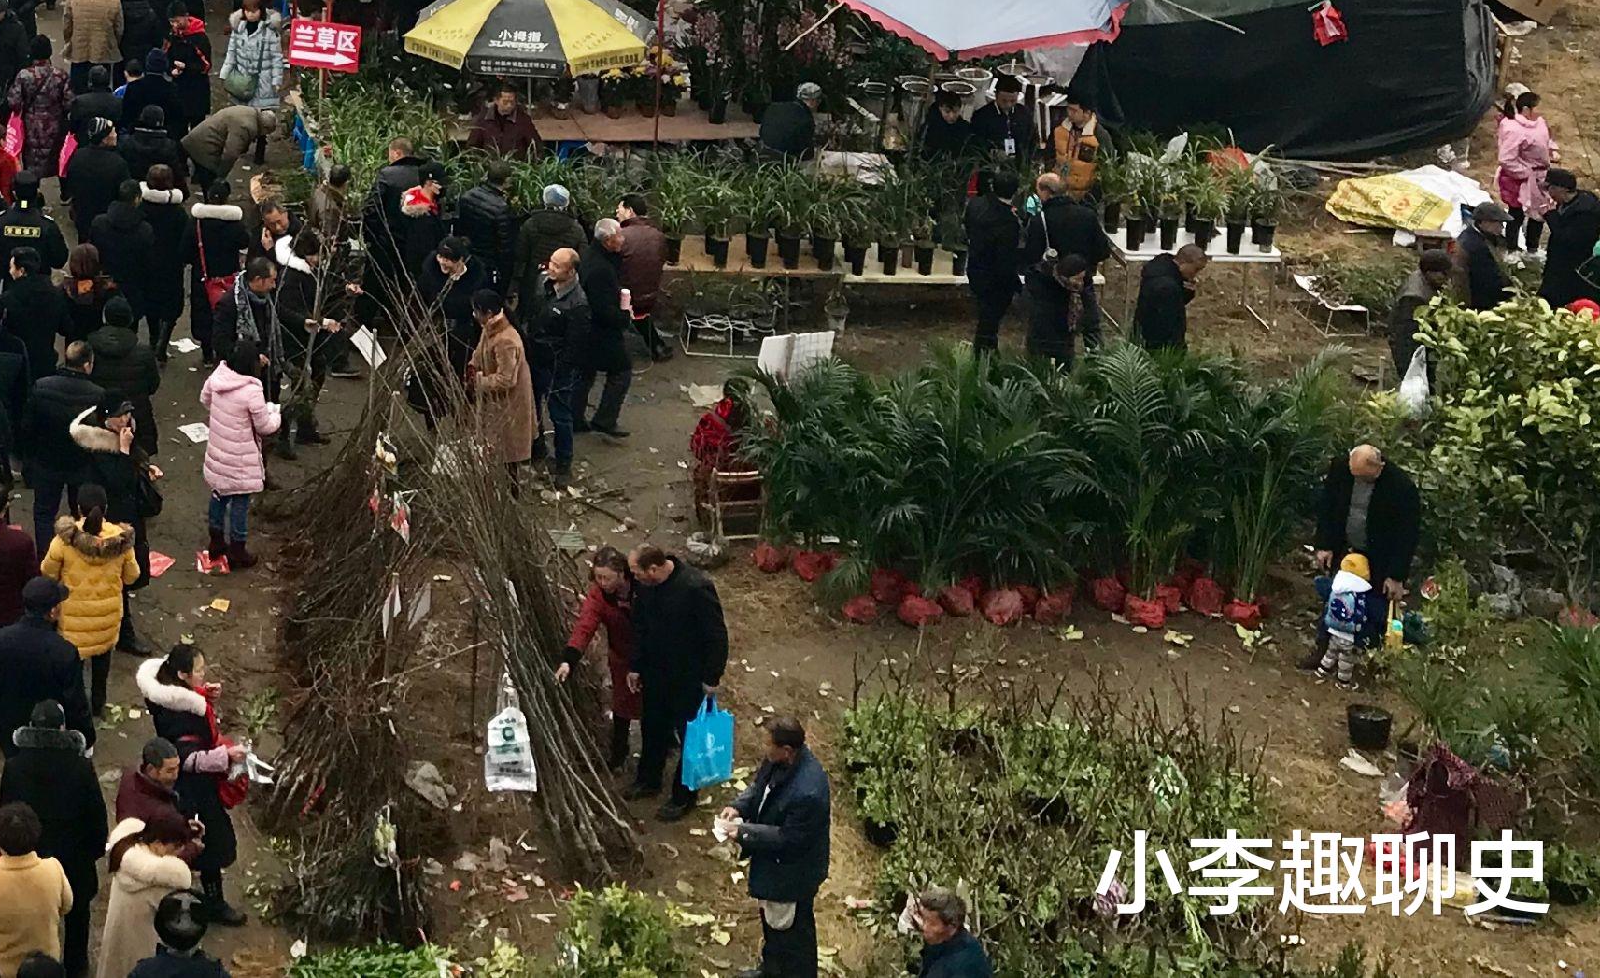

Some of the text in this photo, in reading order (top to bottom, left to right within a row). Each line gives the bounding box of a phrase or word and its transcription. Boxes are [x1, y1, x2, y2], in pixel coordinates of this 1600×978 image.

[293, 24, 358, 53] 兰草区
[498, 29, 541, 42] 小拇指
